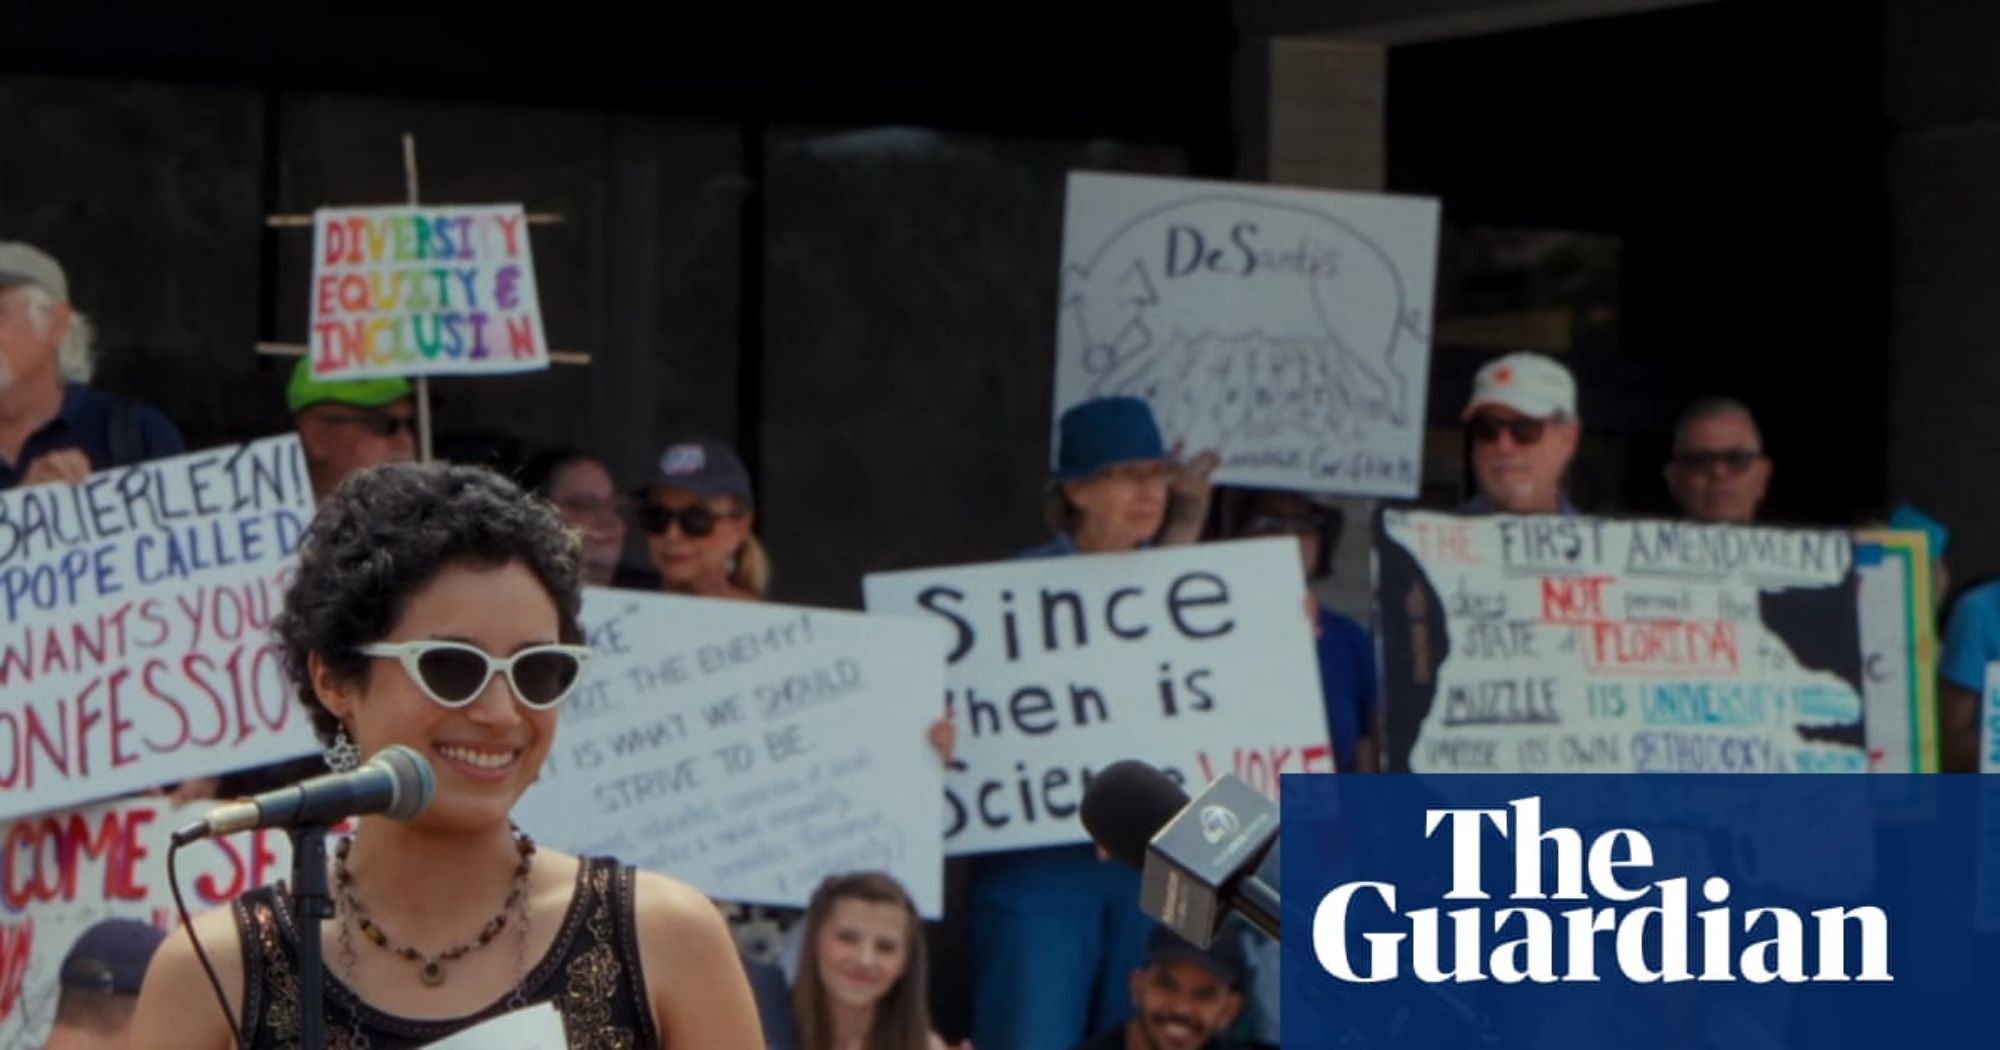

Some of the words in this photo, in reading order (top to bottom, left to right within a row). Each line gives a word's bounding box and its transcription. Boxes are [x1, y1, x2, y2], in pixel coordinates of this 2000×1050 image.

[325, 215, 519, 266] DIVERSITY
[1165, 222, 1345, 279] DeSantis
[318, 267, 480, 315] EQUITY
[315, 312, 536, 373] INCLUSION
[2, 543, 126, 623] POPE
[134, 509, 303, 586] CALLED
[1497, 516, 1606, 567] FIRST
[1624, 521, 1850, 572] AMENDMENT
[0, 597, 171, 686] WANTS
[176, 568, 290, 653] YOU
[916, 571, 1235, 665] Since
[1539, 575, 1615, 622] NOT
[625, 653, 691, 694] THE
[697, 612, 815, 675] ENEMY!
[1591, 621, 1739, 670] FLORIDA
[0, 644, 289, 790] ONFESSIO
[573, 739, 603, 769] IS
[610, 713, 687, 755] WHAT
[702, 695, 747, 728] WE
[754, 656, 863, 718] SHOULD
[944, 682, 1108, 736] hen
[1159, 662, 1214, 717] is
[1445, 675, 1560, 719] MUZZLE
[593, 757, 700, 813] STRIVE
[714, 743, 754, 774] TO
[764, 724, 804, 762] BE
